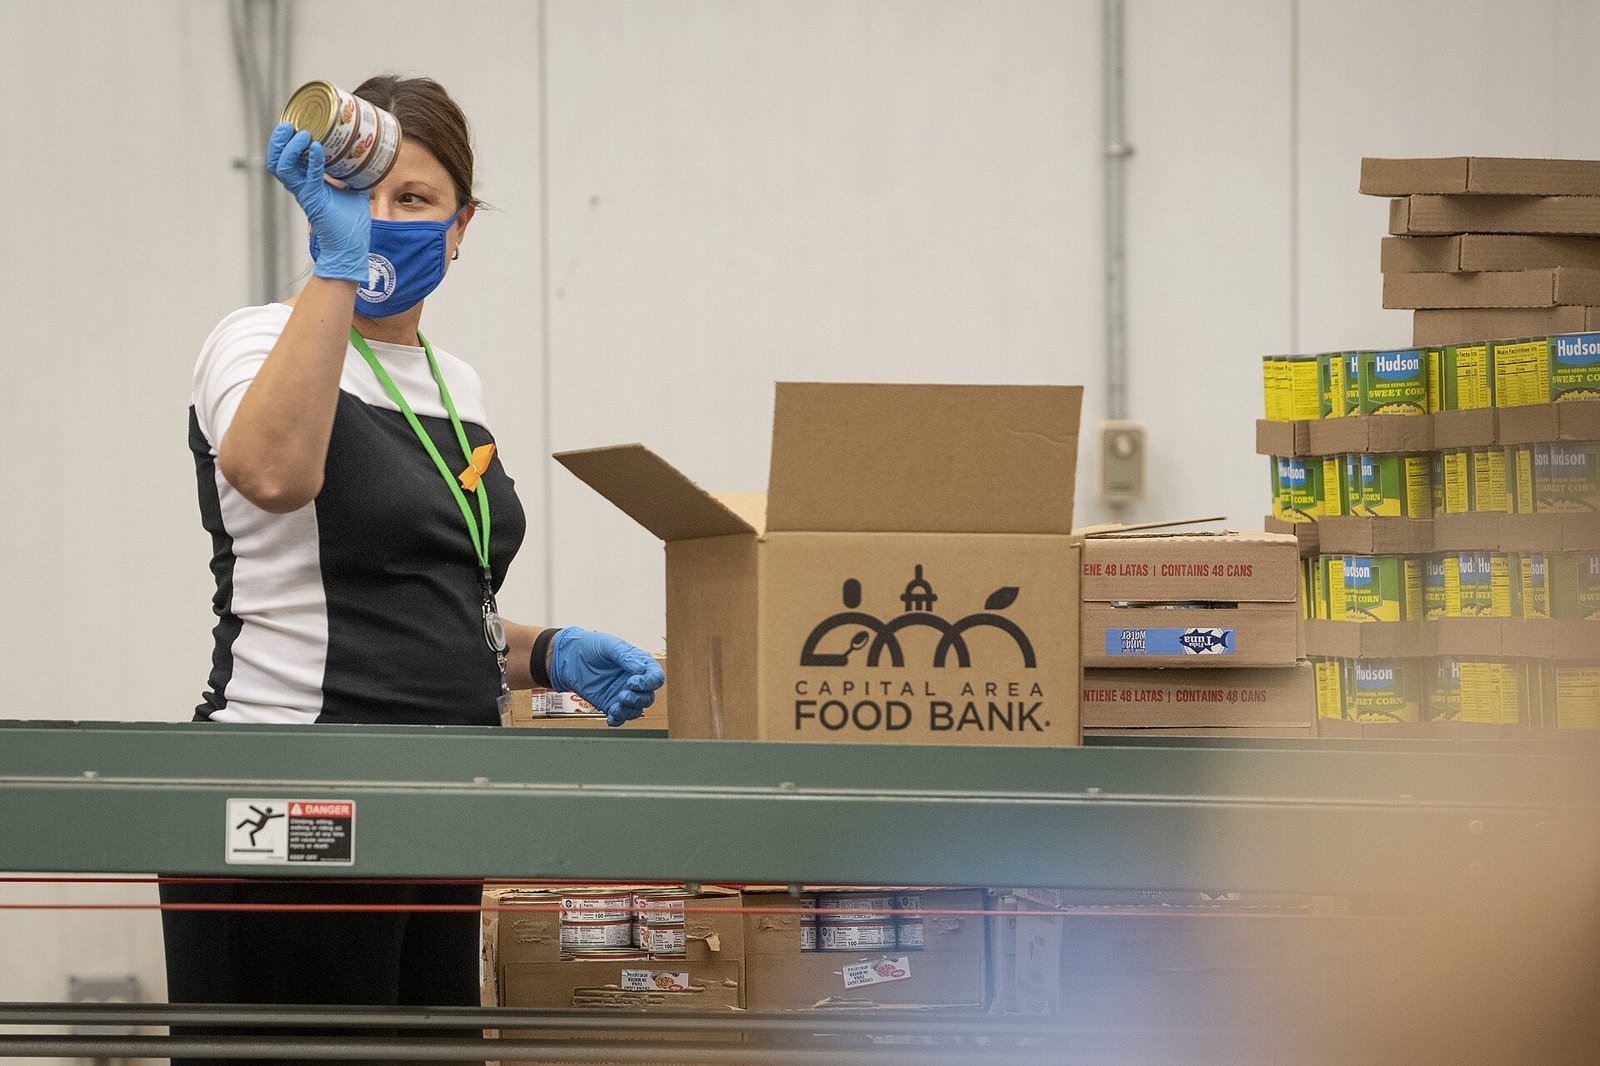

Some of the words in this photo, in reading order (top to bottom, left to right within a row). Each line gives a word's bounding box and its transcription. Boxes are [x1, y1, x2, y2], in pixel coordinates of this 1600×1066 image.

[1376, 354, 1420, 372] Hudson
[1551, 374, 1584, 384] SWEET
[1586, 373, 1600, 382] CO
[1368, 389, 1402, 398] SWEET
[1105, 564, 1117, 577] 48
[1120, 564, 1149, 577] LATAS
[1161, 564, 1209, 577] CONTAINS
[1212, 565, 1224, 577] 48
[1227, 565, 1253, 577] CANS
[1184, 635, 1214, 646] Tuna
[1356, 664, 1393, 681] Hudson
[795, 681, 936, 696] CAPITAL
[961, 682, 1044, 697] AREA
[1083, 689, 1117, 702] NTIENE
[1120, 689, 1132, 702] 48
[1135, 690, 1164, 702] LATAS
[1176, 690, 1224, 702] CONTAINS
[1226, 690, 1238, 704] 48
[1241, 690, 1267, 703] CANS
[1376, 696, 1403, 706] CORN
[795, 700, 913, 731] FOOD
[305, 804, 350, 816] DANGER
